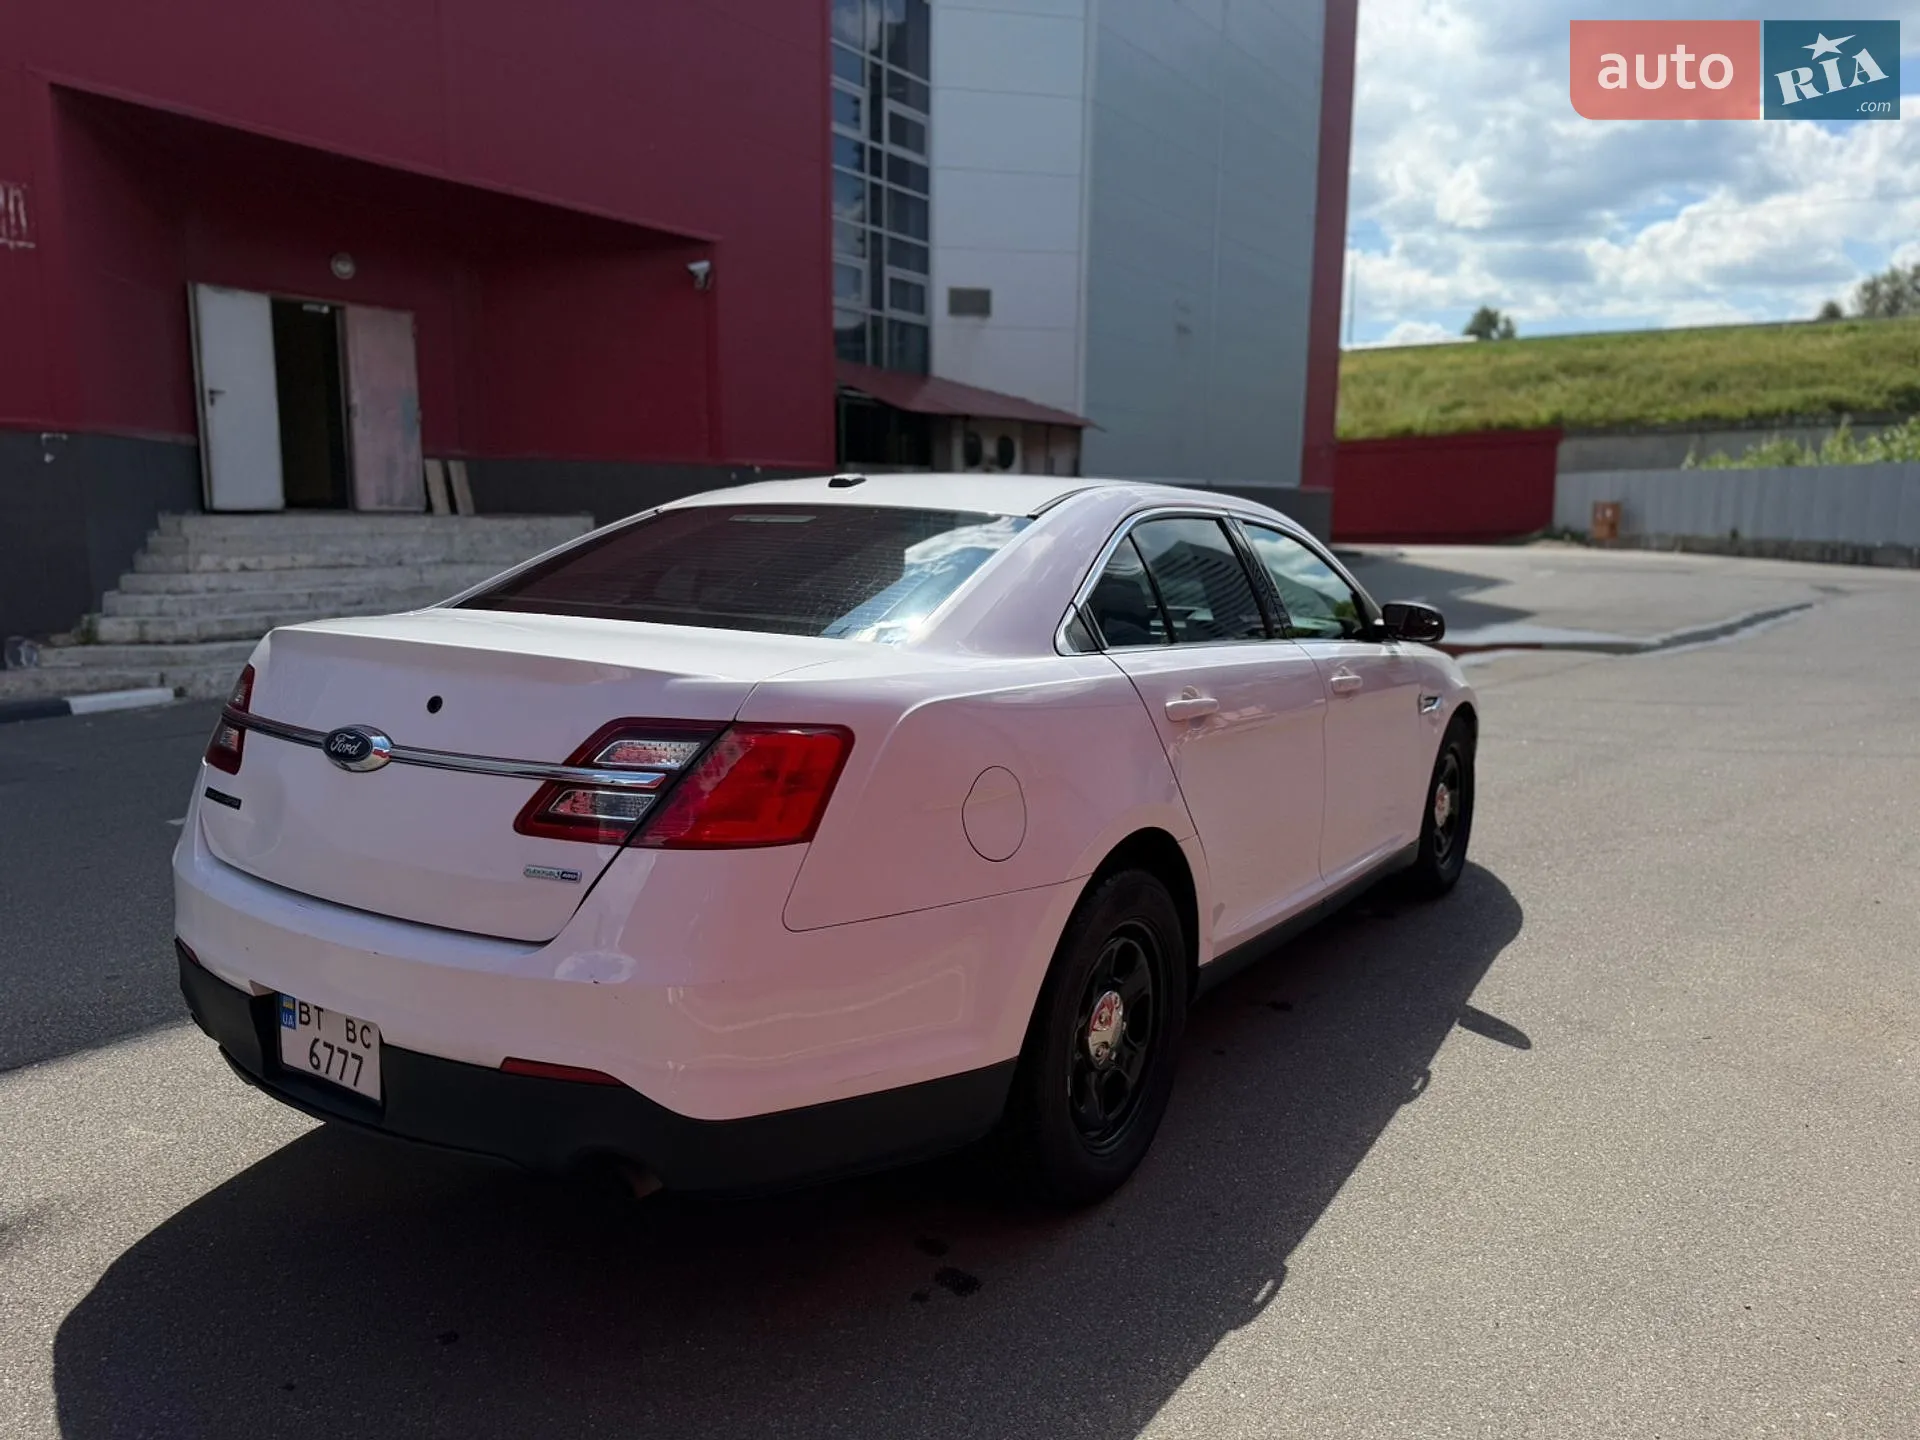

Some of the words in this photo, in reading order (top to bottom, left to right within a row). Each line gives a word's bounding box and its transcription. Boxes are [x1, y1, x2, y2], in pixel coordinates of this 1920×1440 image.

[330, 733, 361, 756] Ford
[282, 1011, 294, 1026] UA
[298, 1001, 324, 1031] BT
[345, 1018, 371, 1049] BC
[309, 1037, 363, 1087] 6777
